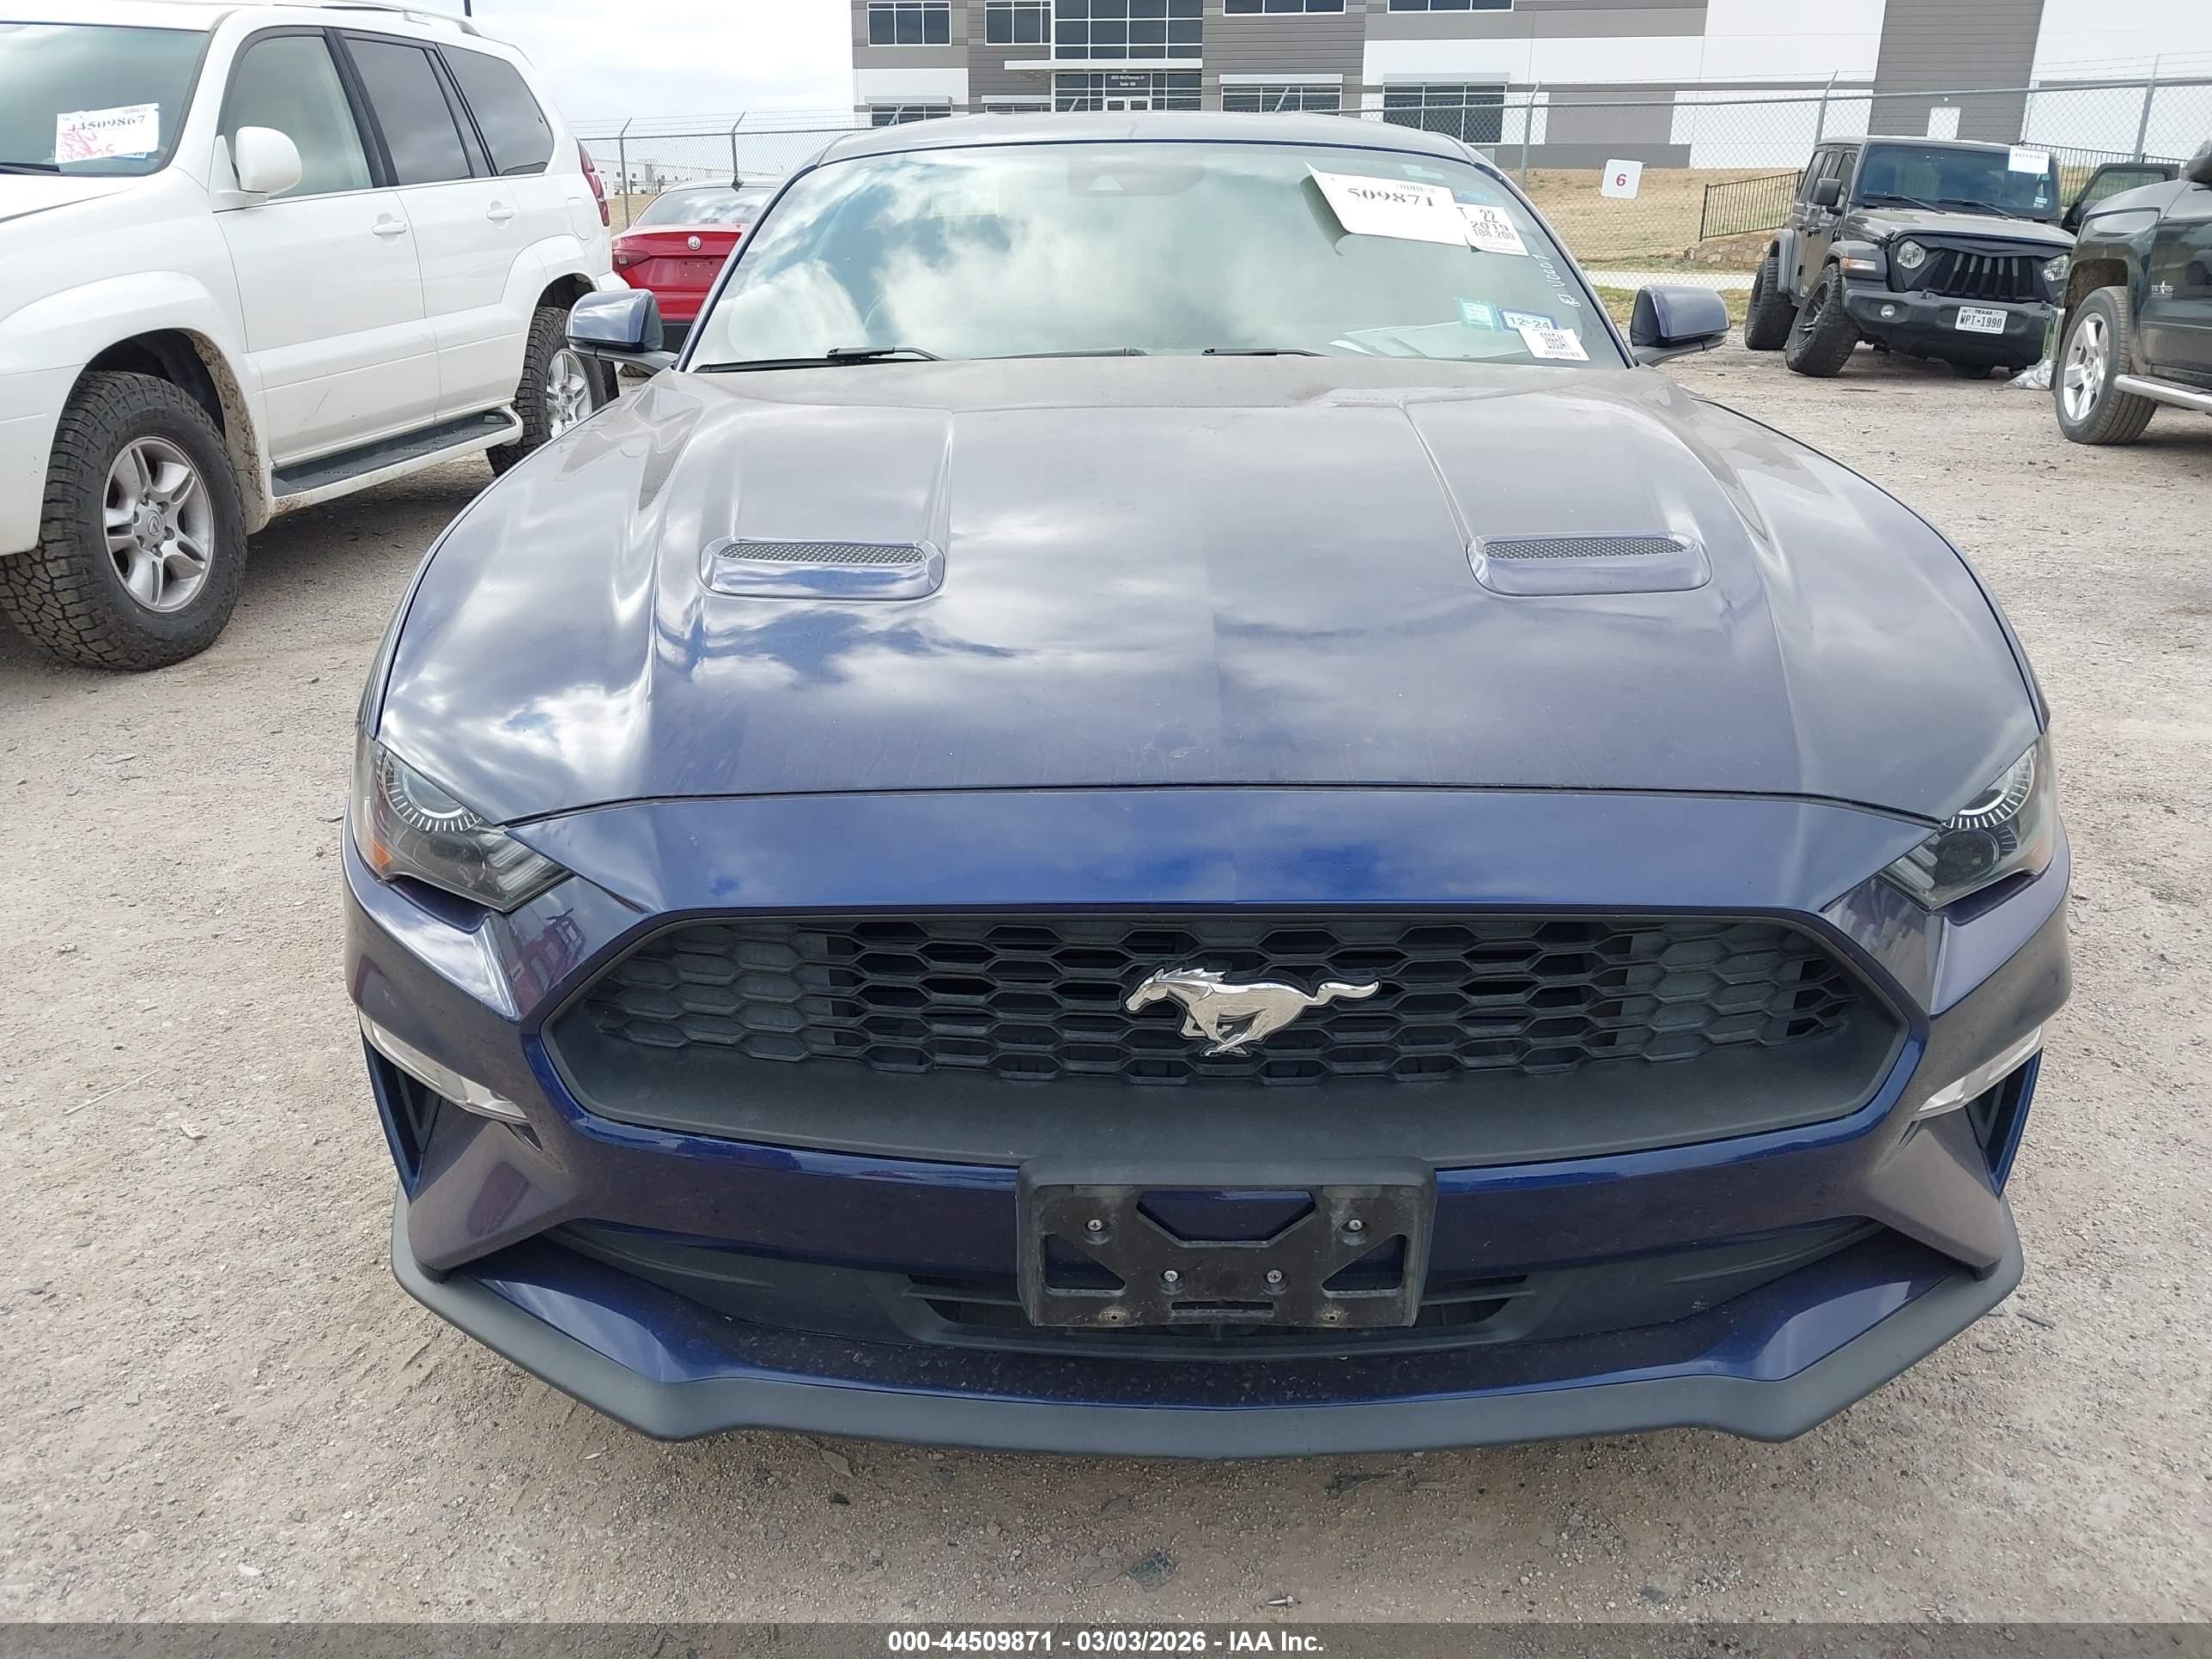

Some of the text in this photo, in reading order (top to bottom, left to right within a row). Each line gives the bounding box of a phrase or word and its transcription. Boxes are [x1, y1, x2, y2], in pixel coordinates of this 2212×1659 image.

[1616, 173, 1627, 186] 6
[1479, 209, 1499, 224] 22
[1470, 221, 1510, 233] 2019
[1960, 313, 2002, 329] WPT-1990
